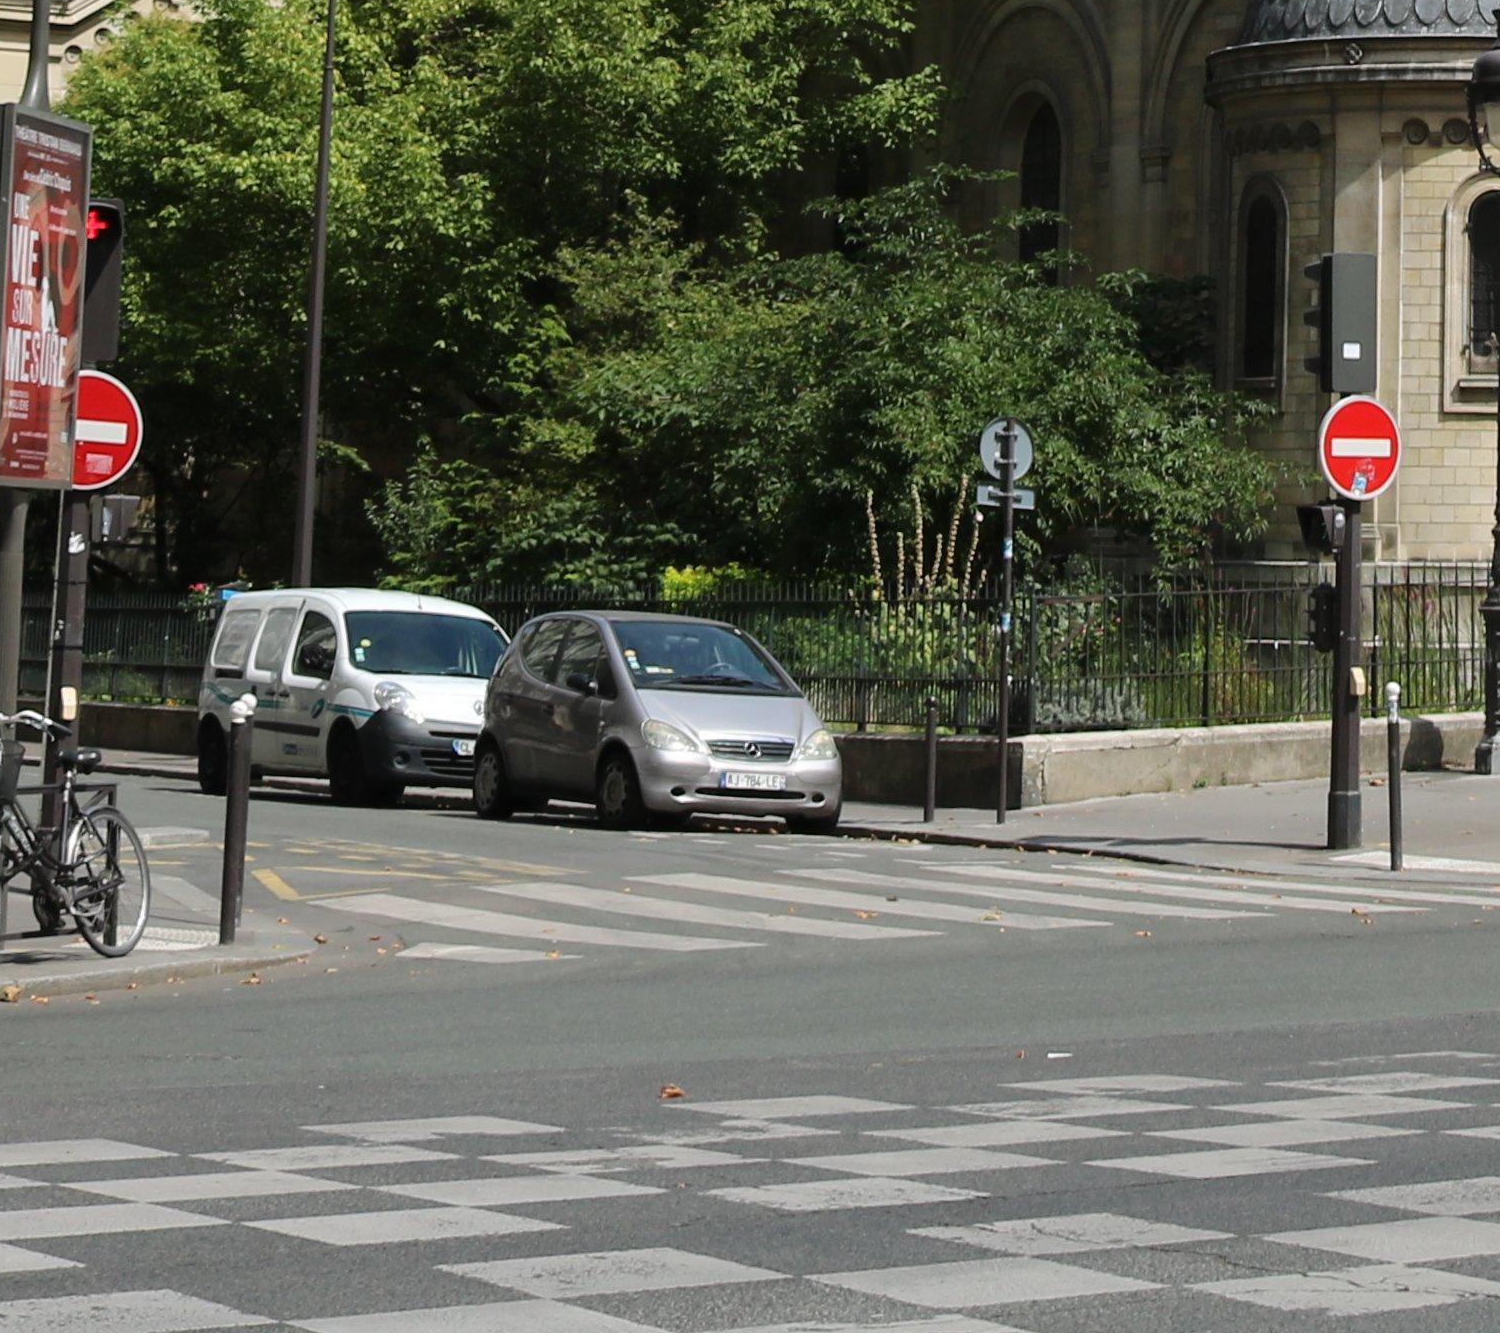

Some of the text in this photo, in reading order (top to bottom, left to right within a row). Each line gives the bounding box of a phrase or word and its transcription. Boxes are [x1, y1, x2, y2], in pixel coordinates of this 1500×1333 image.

[14, 192, 30, 220] UNE
[11, 223, 39, 288] VIE
[12, 289, 33, 326] SUR
[4, 326, 68, 388] MESURE
